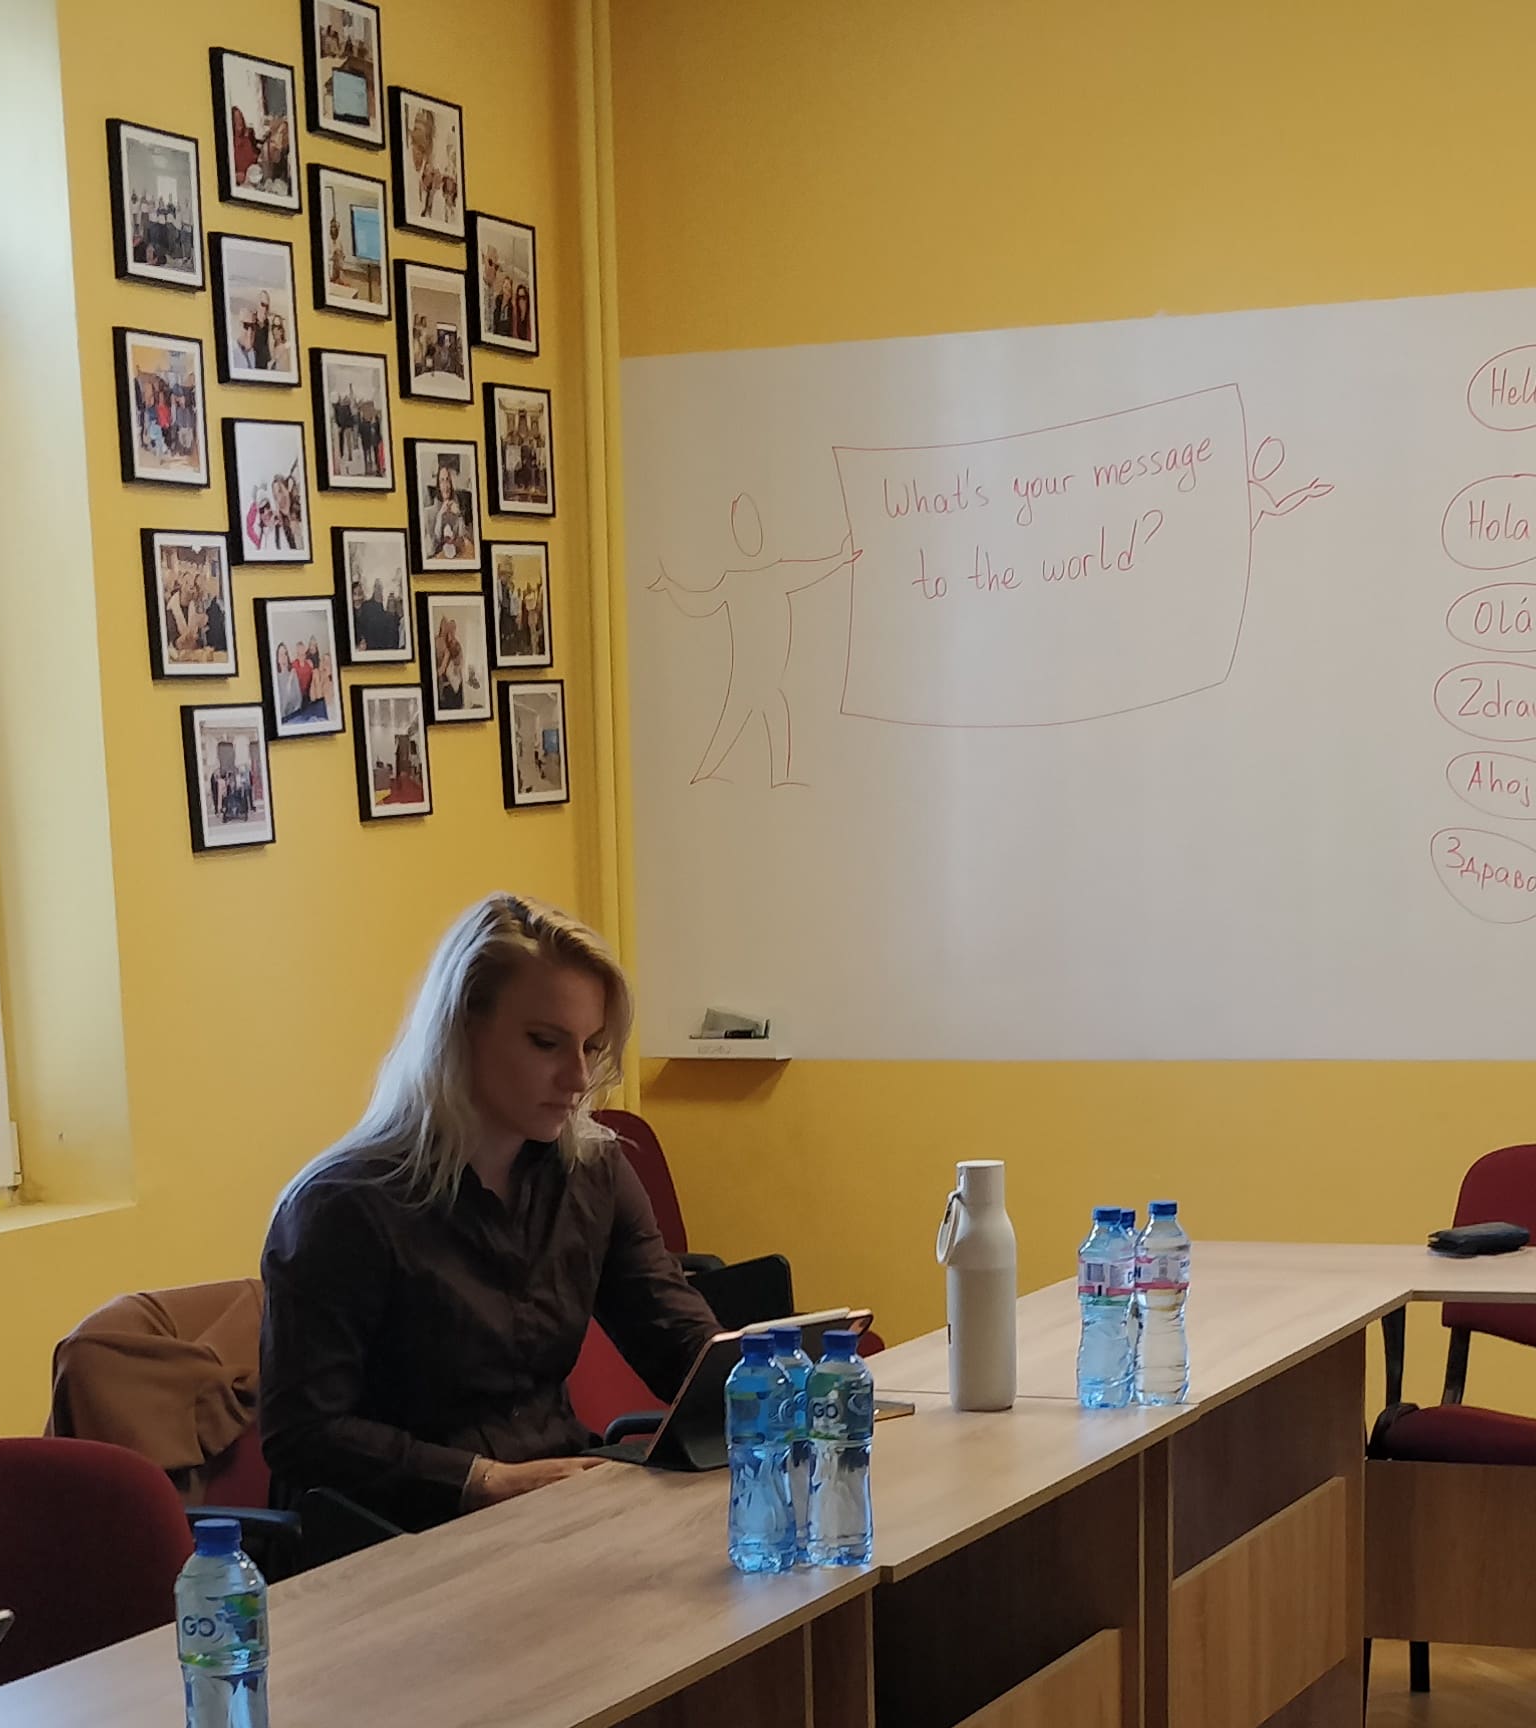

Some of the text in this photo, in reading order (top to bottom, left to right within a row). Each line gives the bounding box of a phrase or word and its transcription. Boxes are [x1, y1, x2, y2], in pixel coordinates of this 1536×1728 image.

[882, 437, 1213, 527] What's your message
[912, 509, 1164, 601] to the world?
[813, 1401, 839, 1420] GO
[182, 1615, 216, 1637] GO
